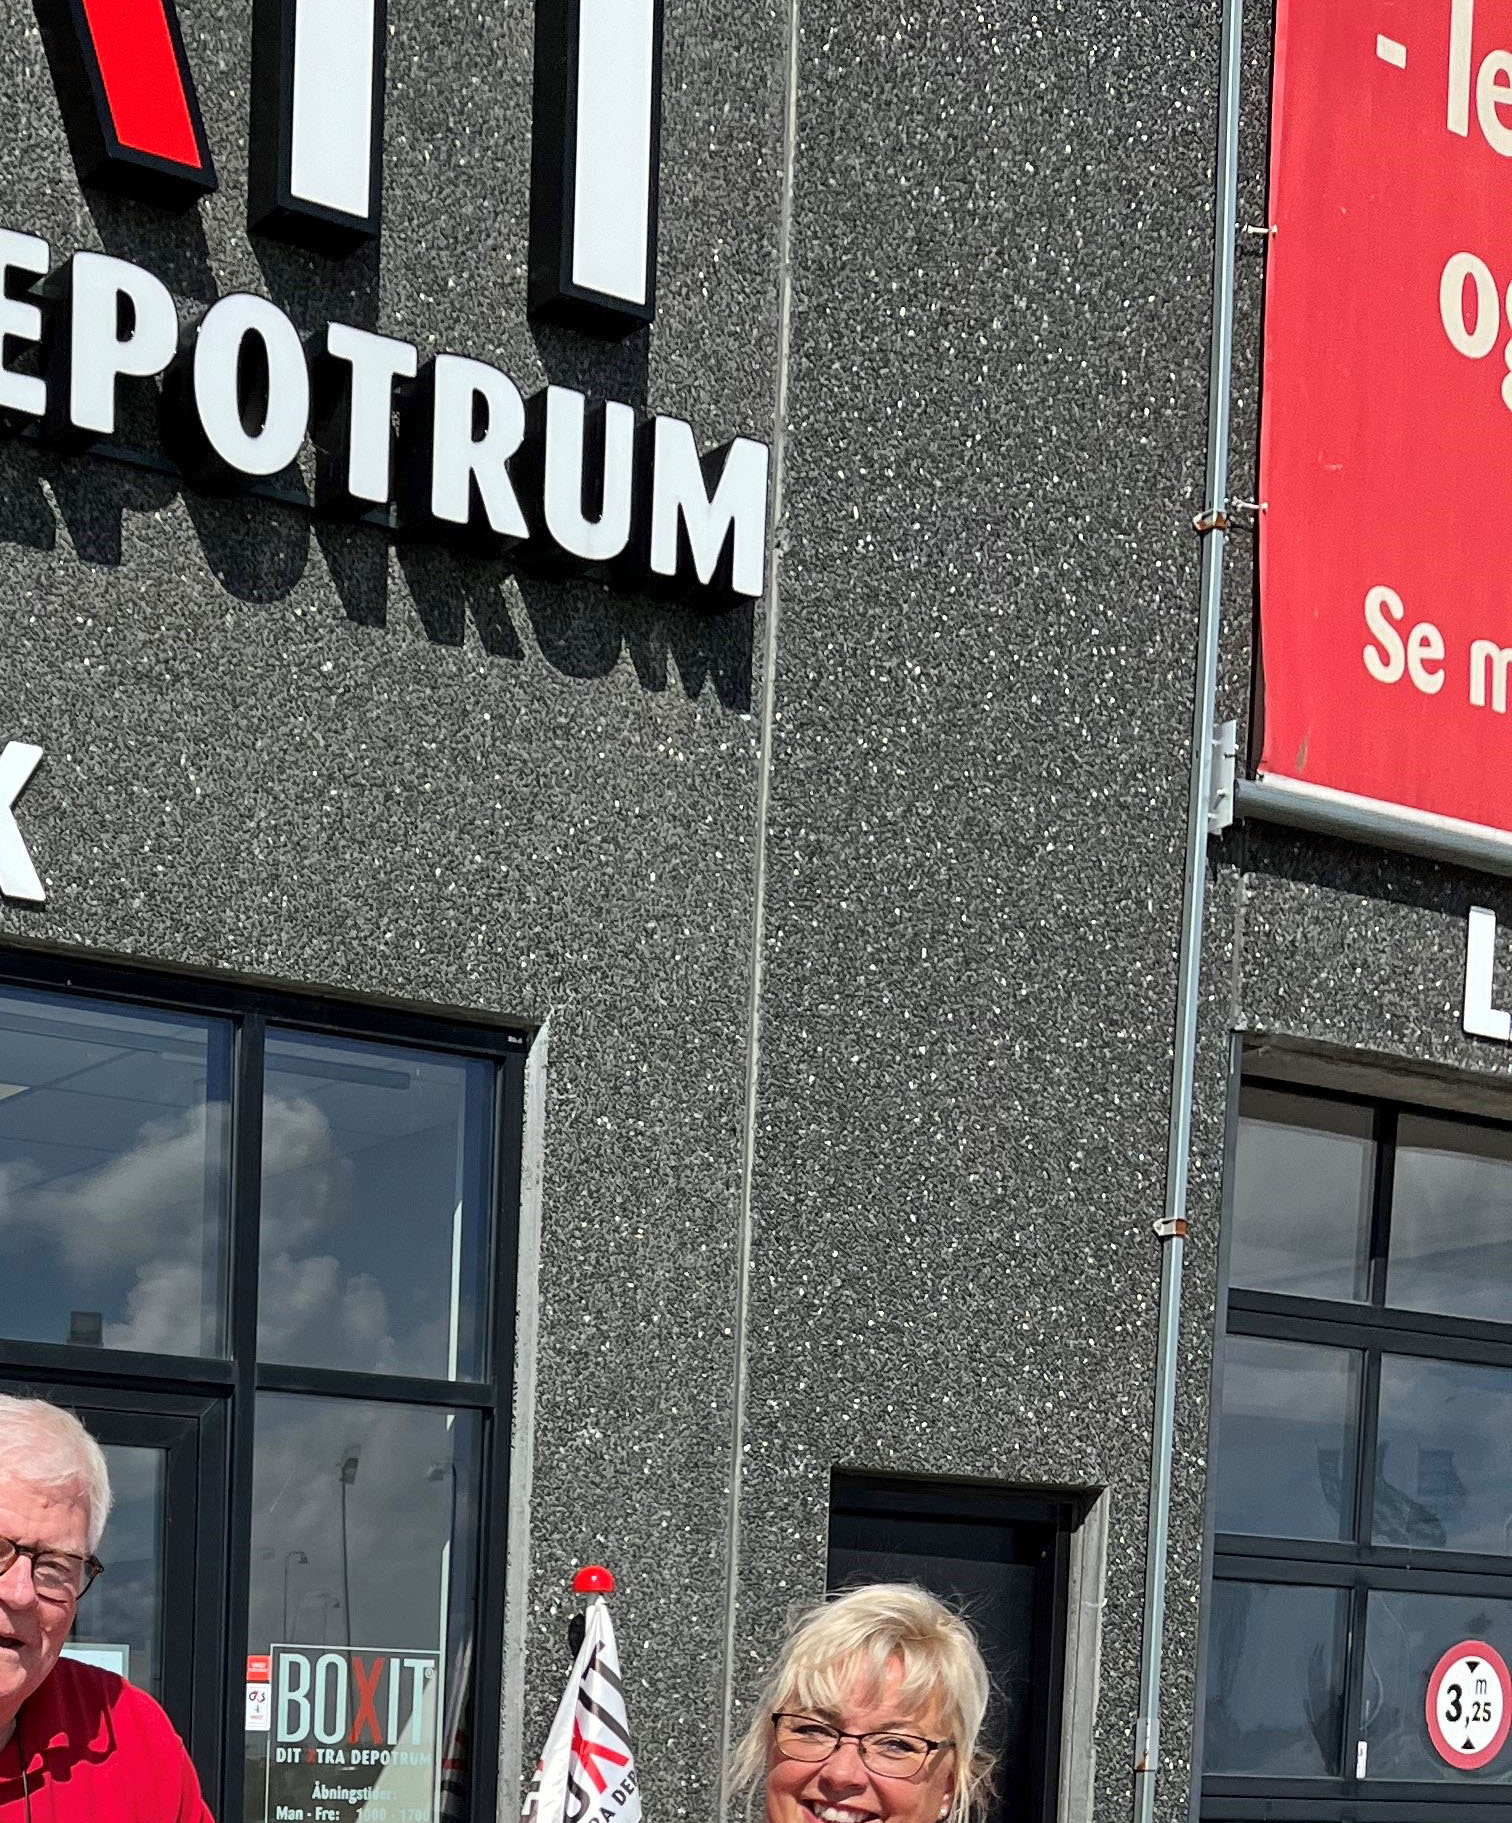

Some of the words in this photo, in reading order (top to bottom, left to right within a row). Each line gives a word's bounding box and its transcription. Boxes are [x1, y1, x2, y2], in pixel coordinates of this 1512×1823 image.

[1440, 251, 1512, 410] o
[1363, 585, 1445, 695] Se
[276, 1653, 435, 1746] BOXIT
[1475, 1677, 1487, 1695] m
[276, 1748, 302, 1763] DIT
[276, 1806, 303, 1821] Man
[315, 1807, 340, 1821] Fre:
